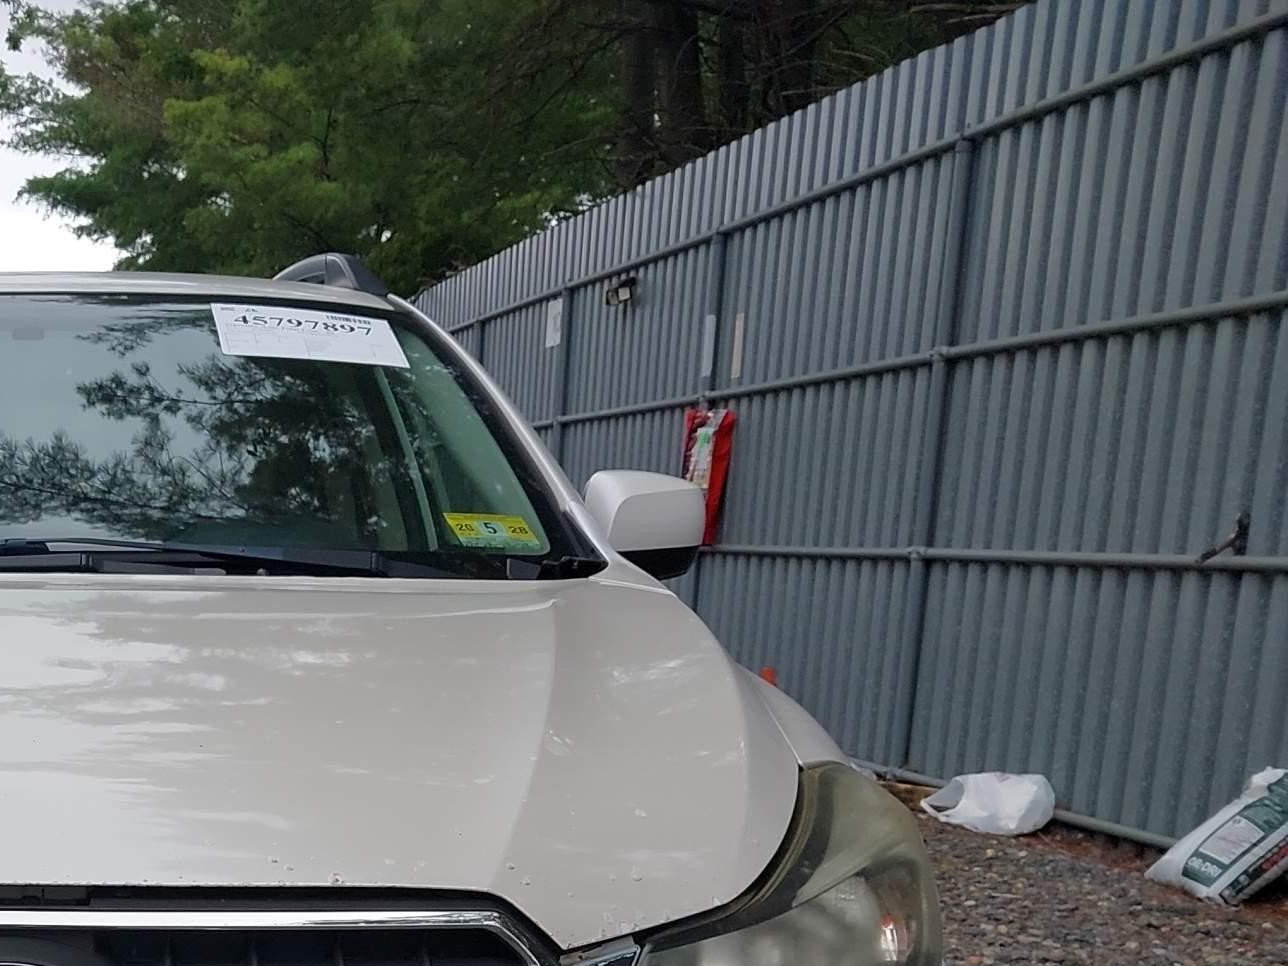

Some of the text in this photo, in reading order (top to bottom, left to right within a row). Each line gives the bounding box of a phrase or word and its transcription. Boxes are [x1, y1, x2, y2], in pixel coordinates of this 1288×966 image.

[234, 314, 373, 336] 45797897
[455, 522, 529, 534] 20 5 28
